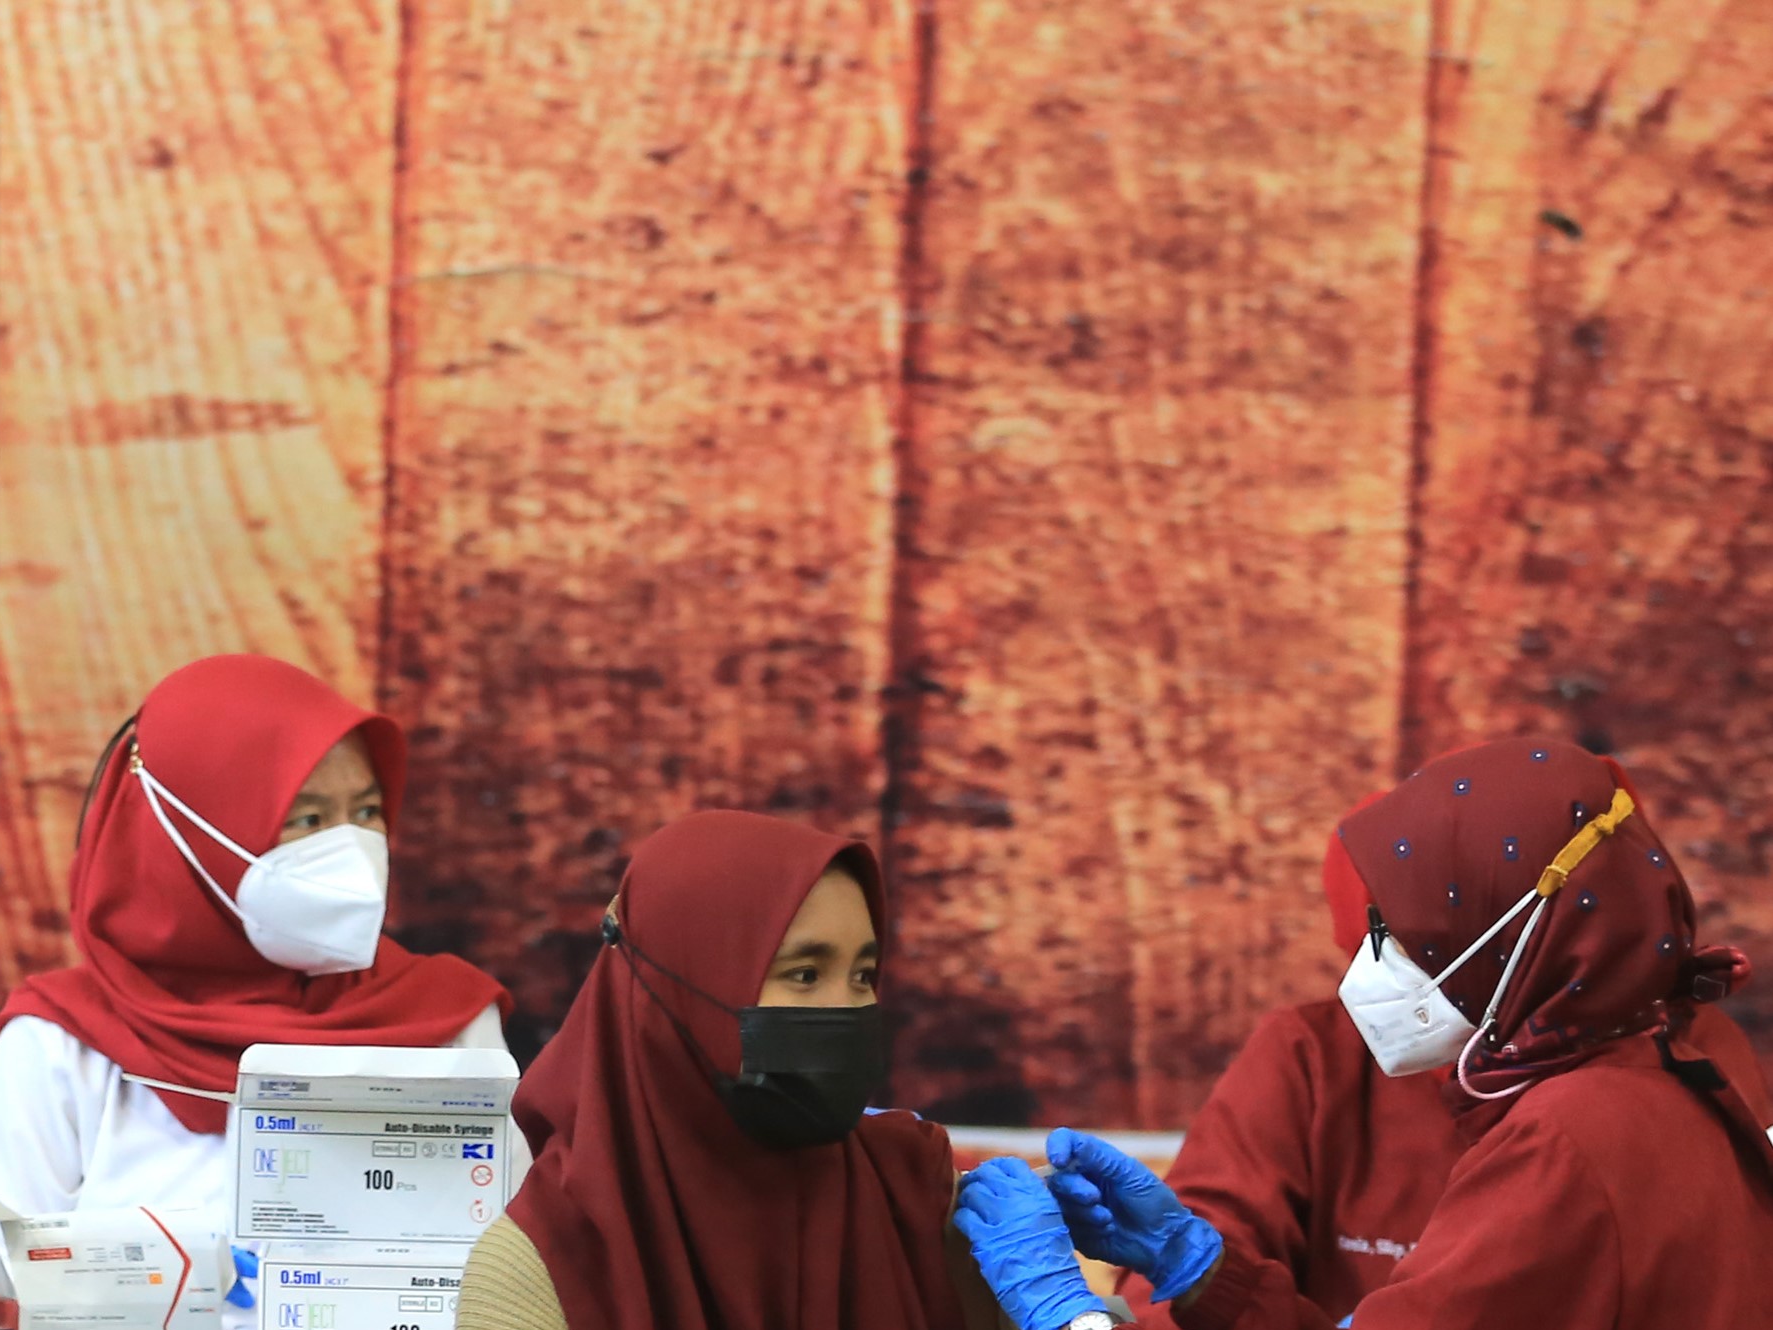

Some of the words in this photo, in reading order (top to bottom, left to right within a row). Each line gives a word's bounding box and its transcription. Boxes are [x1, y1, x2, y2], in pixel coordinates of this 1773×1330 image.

[256, 1115, 295, 1130] 0.5ml
[384, 1122, 451, 1134] Auto-Disable
[364, 1169, 393, 1190] 100
[280, 1269, 321, 1285] 0.5ml
